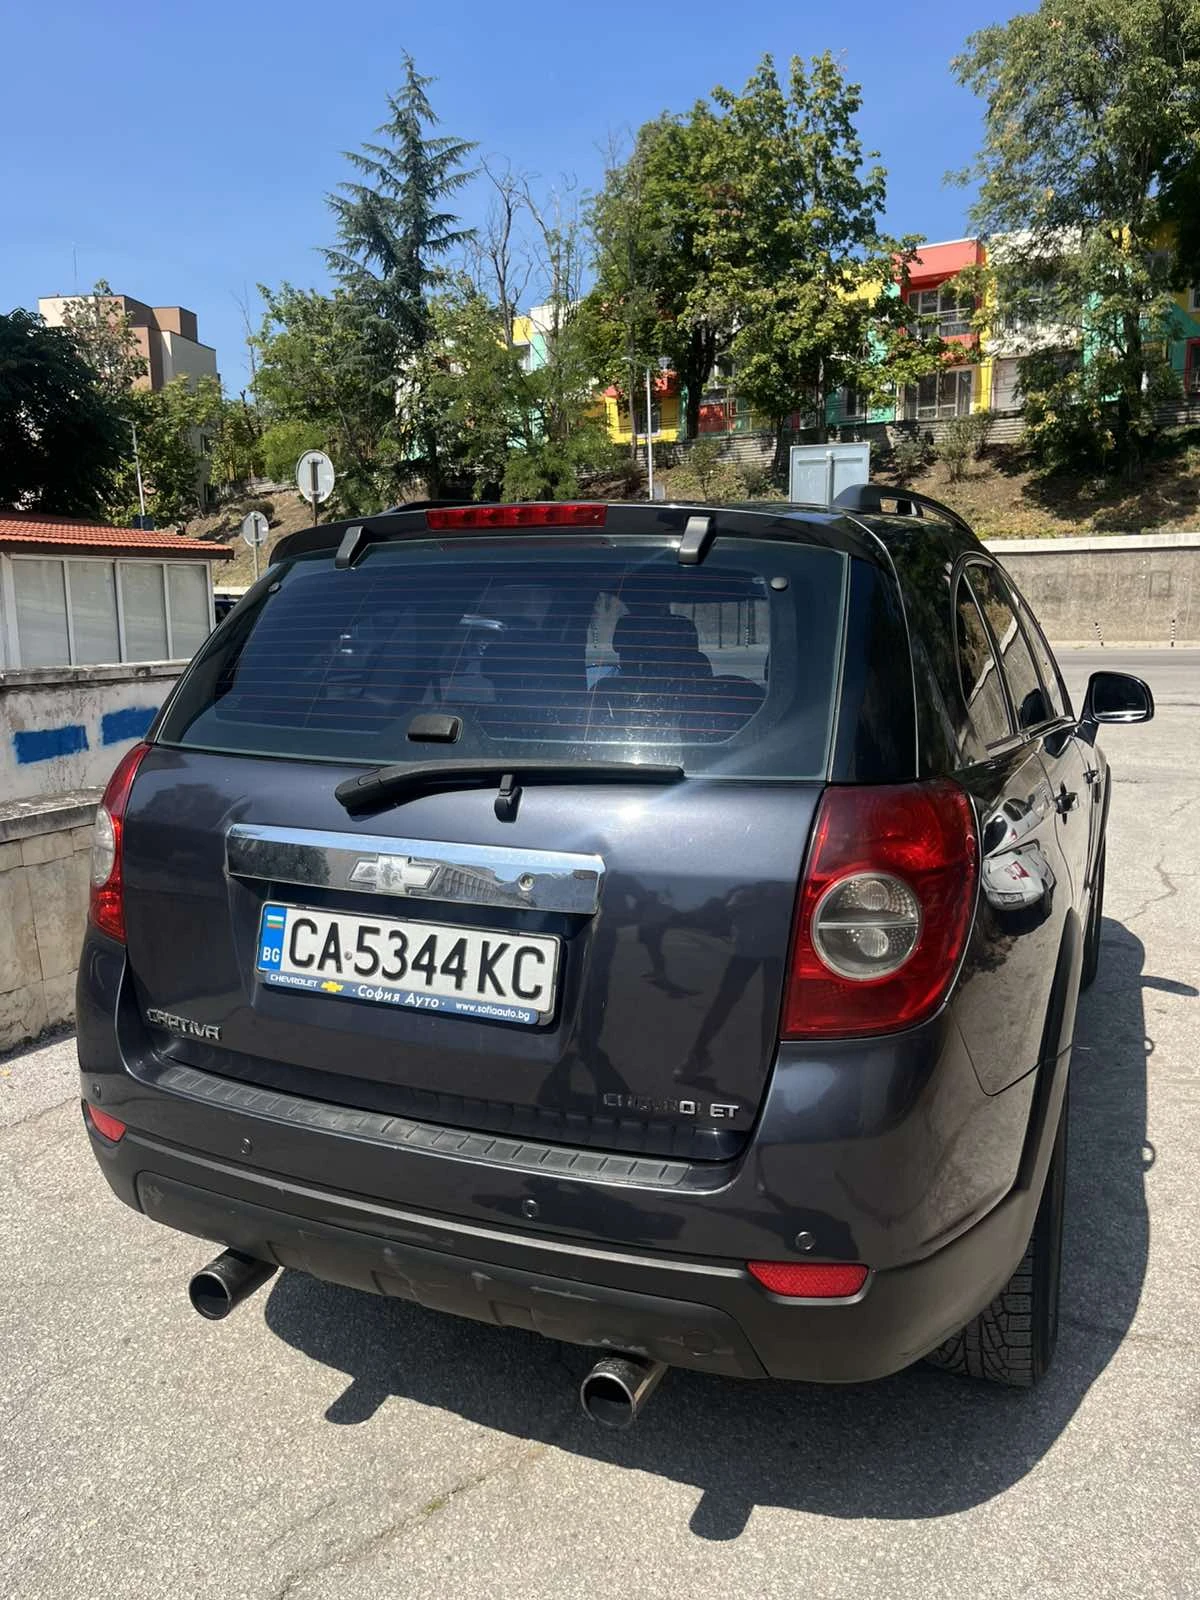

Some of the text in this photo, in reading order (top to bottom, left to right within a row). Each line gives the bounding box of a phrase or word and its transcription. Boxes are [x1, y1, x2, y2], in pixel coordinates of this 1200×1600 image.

[262, 946, 281, 963] BG
[270, 973, 319, 988] CHEVROLET
[358, 985, 439, 1008] София Ауто
[455, 1002, 530, 1021] www.sofiaauto.bg
[146, 1008, 221, 1040] CAPTIVA
